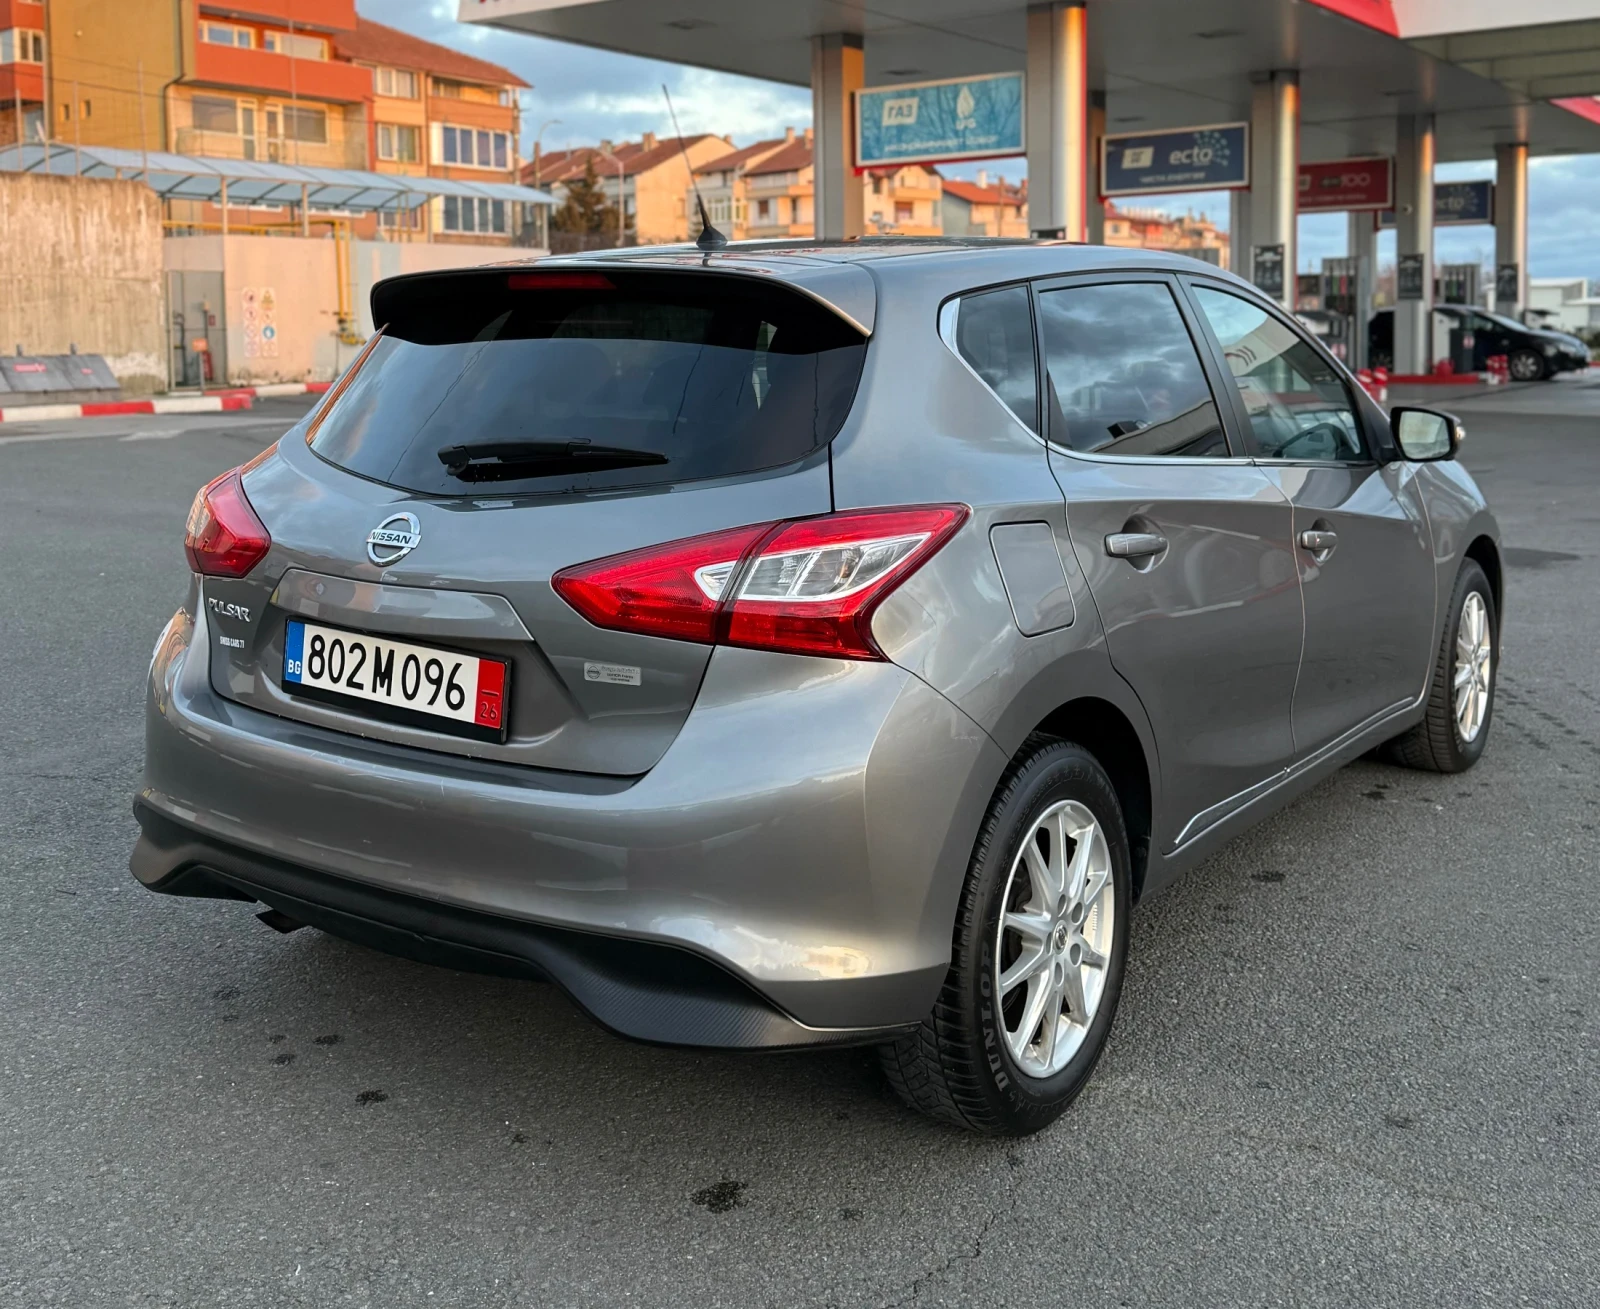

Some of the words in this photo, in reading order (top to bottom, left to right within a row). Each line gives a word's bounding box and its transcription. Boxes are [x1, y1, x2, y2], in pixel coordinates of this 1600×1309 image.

[1169, 145, 1213, 166] ecto
[370, 530, 412, 545] NISSAN
[208, 597, 251, 623] PULSAR
[287, 660, 301, 675] BG
[479, 702, 498, 720] 26
[980, 939, 1010, 1092] DUNLOP
